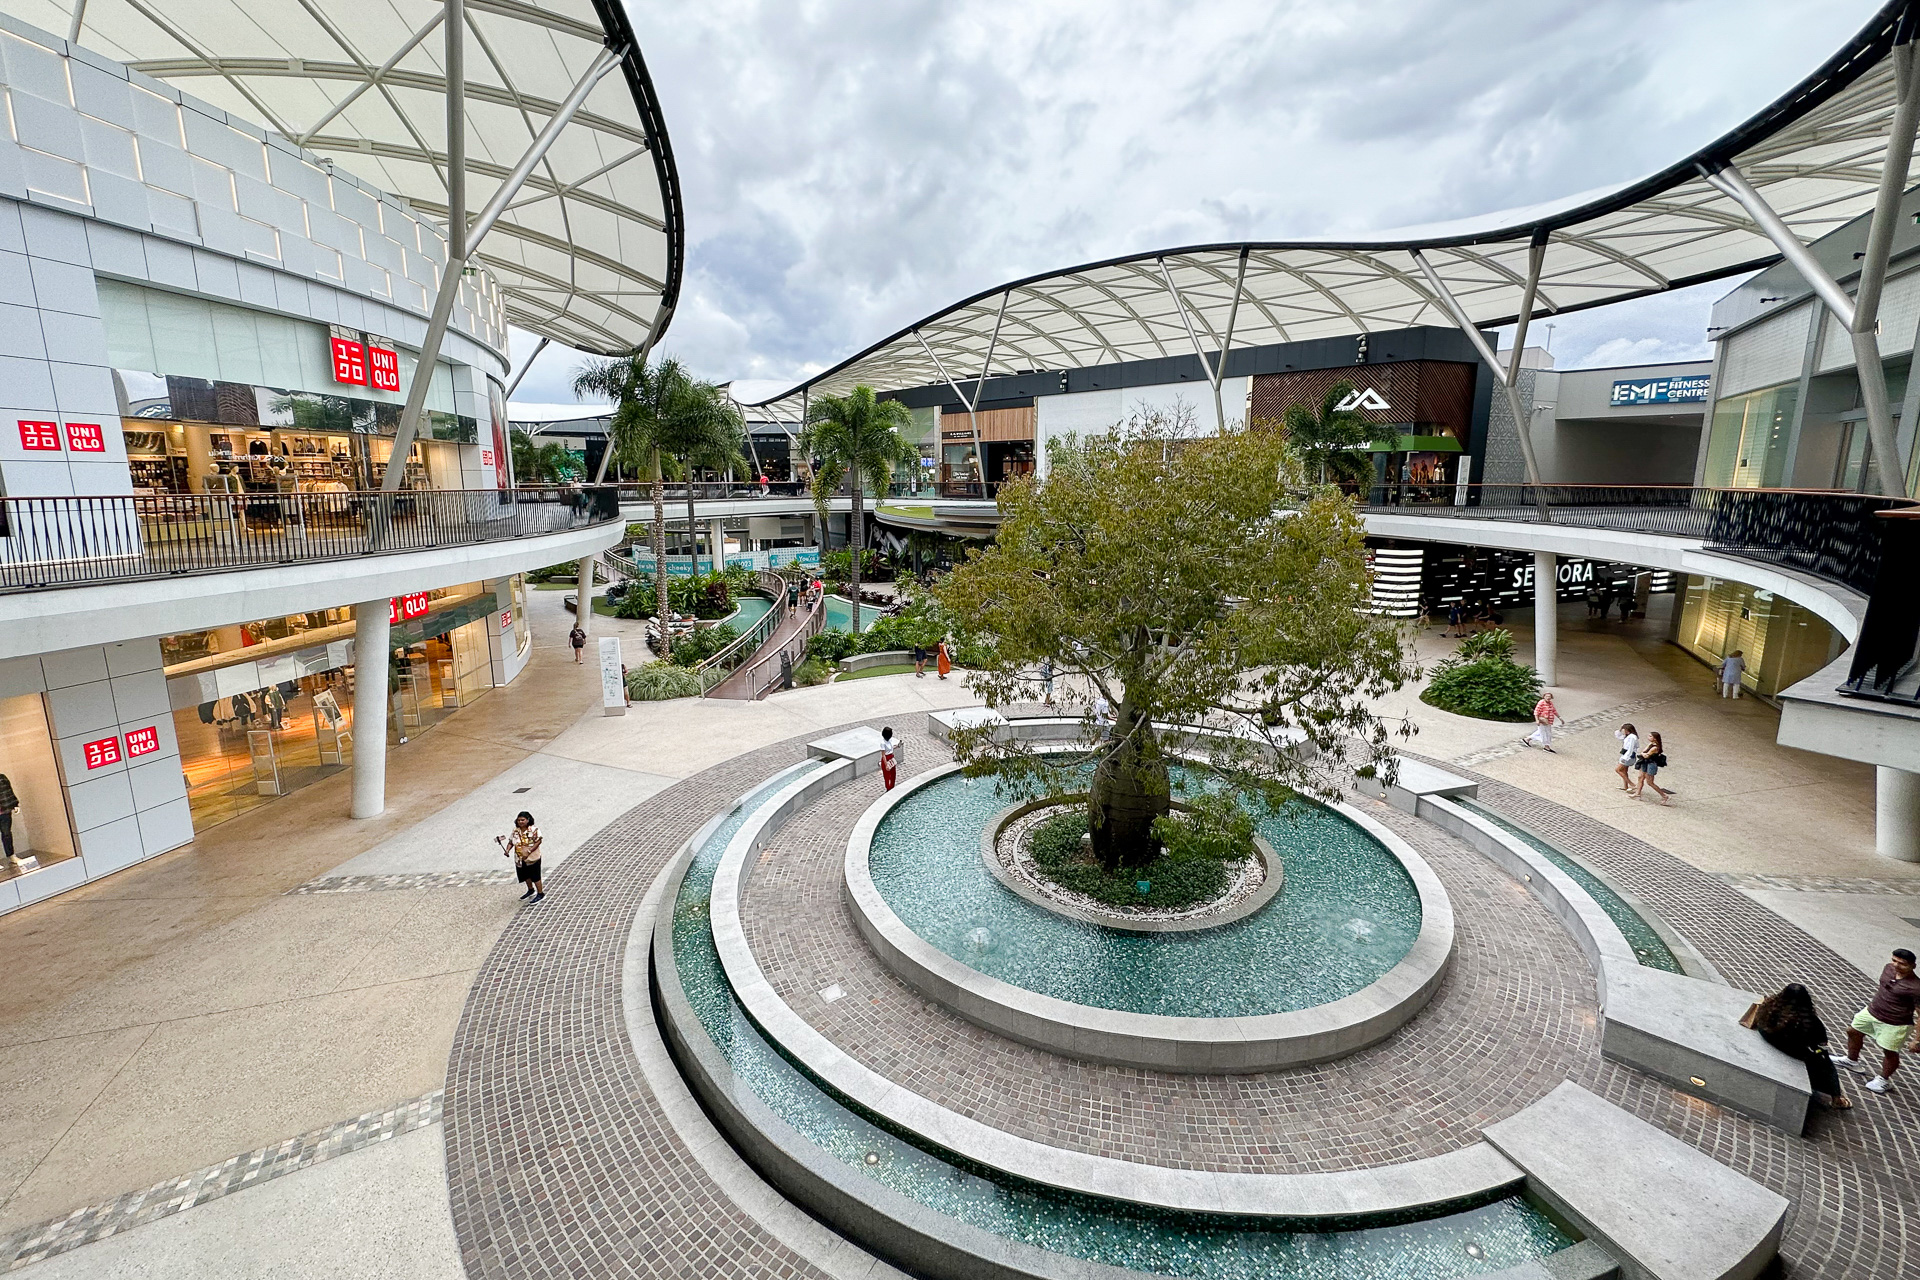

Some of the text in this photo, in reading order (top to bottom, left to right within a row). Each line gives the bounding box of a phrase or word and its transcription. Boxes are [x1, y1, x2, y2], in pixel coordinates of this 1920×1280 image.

[337, 344, 361, 363] ユニ
[372, 352, 394, 370] UNI
[339, 362, 363, 380] クロ
[374, 369, 397, 387] QLO
[1613, 381, 1668, 401] EMF
[1668, 379, 1711, 390] FITNESS
[1667, 388, 1710, 398] CENTRE
[24, 424, 53, 436] ユニ
[69, 426, 96, 438] UNI
[72, 438, 100, 450] QLO
[667, 563, 691, 572] cheeky
[1512, 562, 1593, 588] SEORA
[405, 597, 426, 616] QLO
[129, 730, 152, 744] UNI
[89, 740, 115, 755] ユニ
[131, 739, 156, 755] QLO
